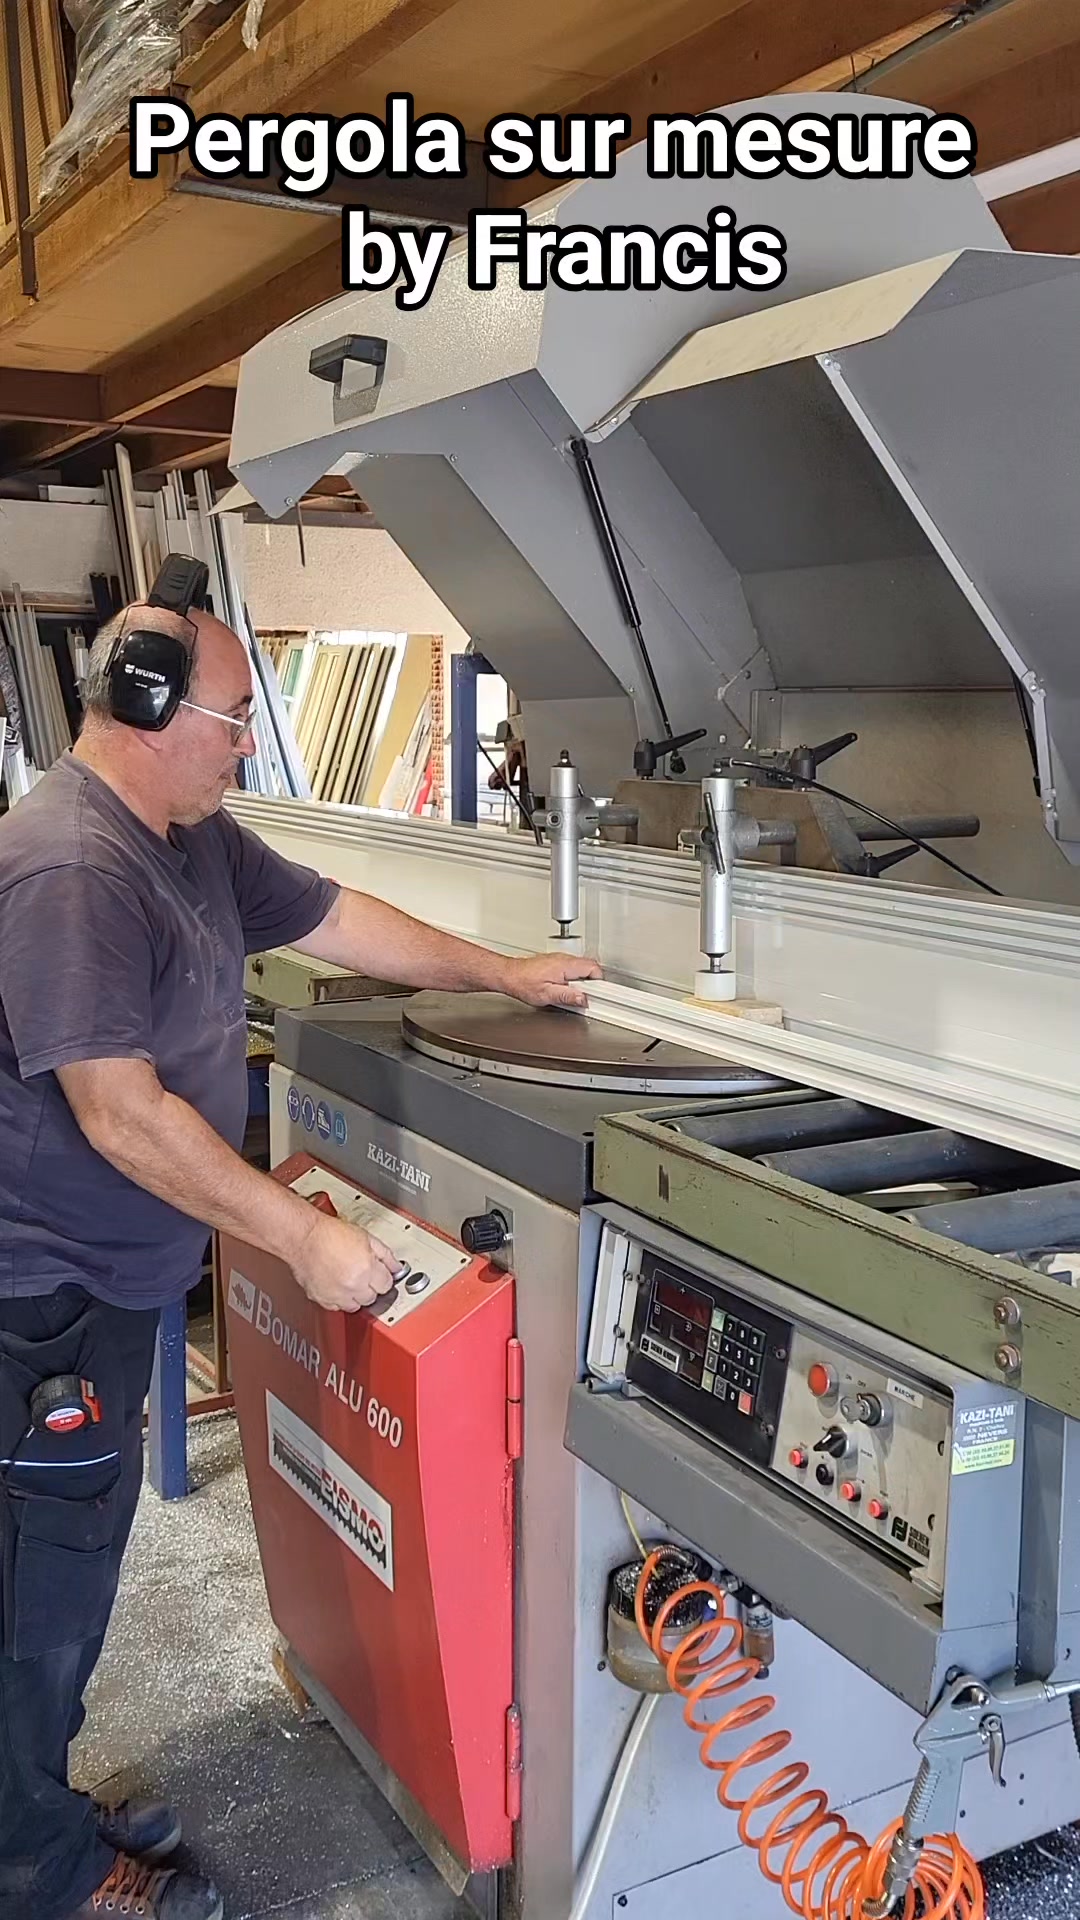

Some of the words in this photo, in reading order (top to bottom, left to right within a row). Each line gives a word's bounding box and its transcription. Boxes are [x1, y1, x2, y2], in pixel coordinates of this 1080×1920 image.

[366, 1142, 432, 1193] KAZI-TANI
[324, 1362, 364, 1413] ALU
[366, 1397, 403, 1448] 600
[960, 1404, 1014, 1425] KAZI-TANI
[977, 1428, 1008, 1439] NEVERS
[321, 1467, 386, 1553] EISMO
